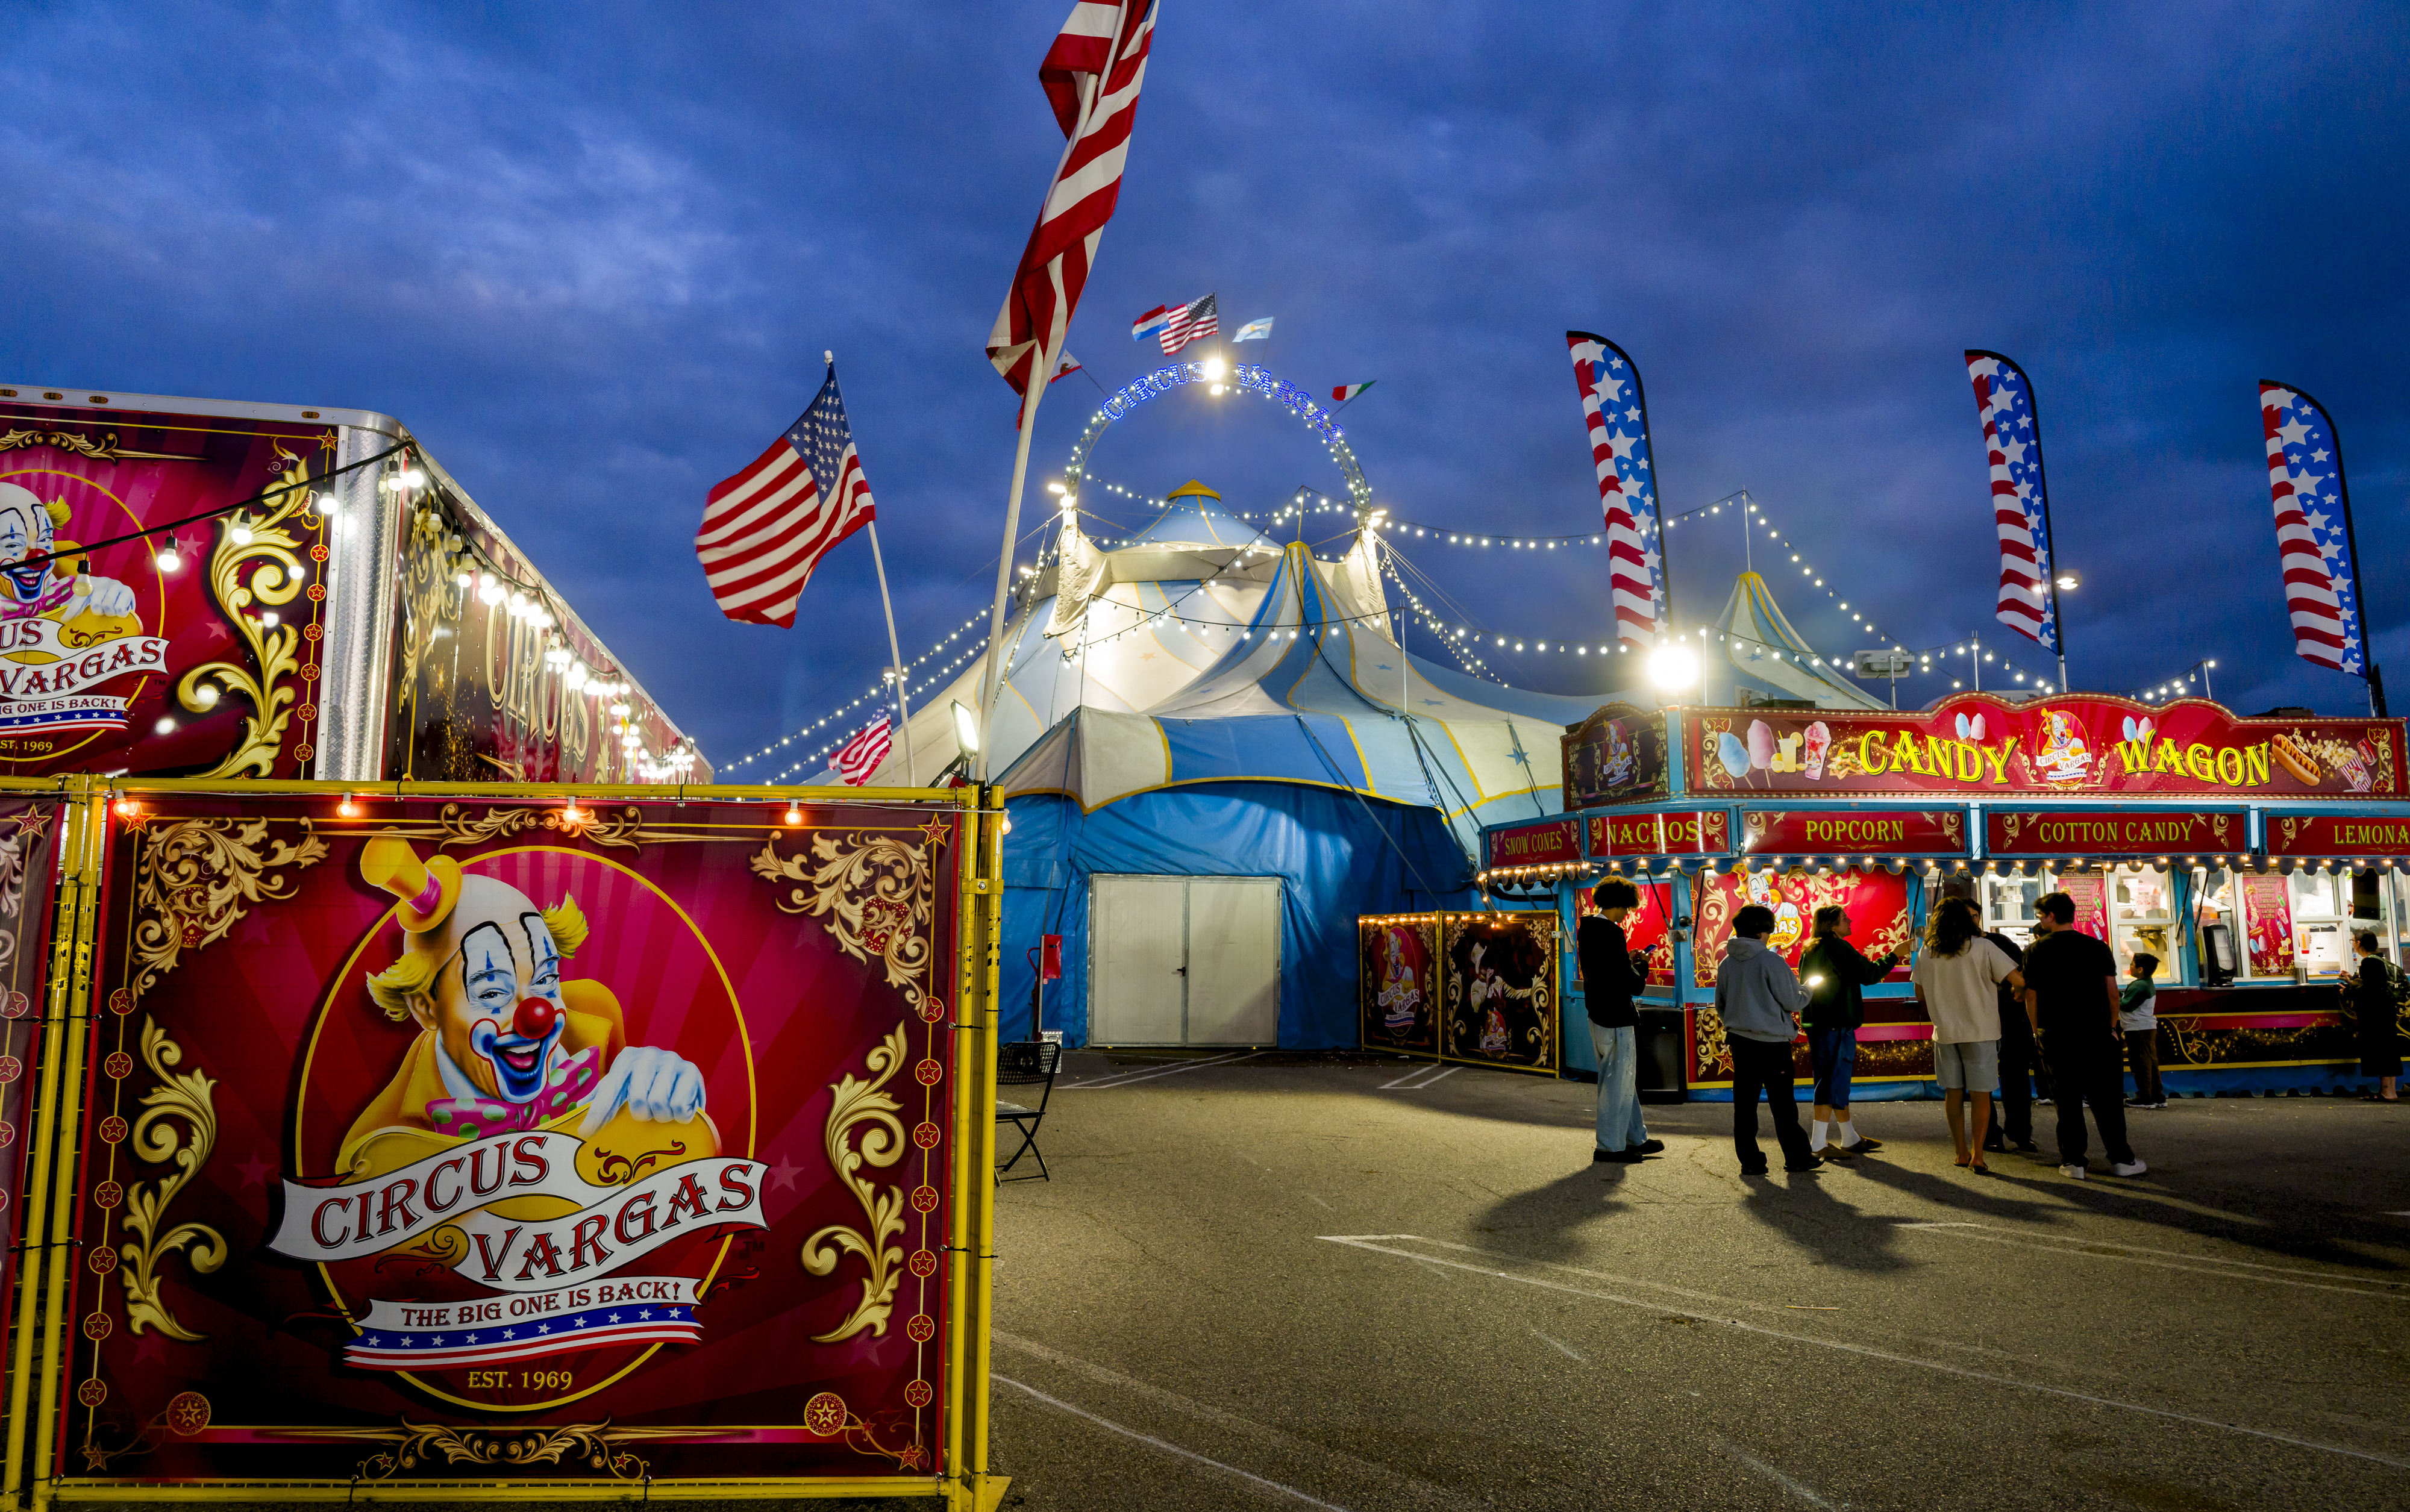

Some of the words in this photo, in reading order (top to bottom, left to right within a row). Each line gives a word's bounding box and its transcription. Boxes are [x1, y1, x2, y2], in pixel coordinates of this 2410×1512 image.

[1103, 361, 1207, 420] CIRCUS
[1238, 364, 1346, 443] VARGAS
[0, 640, 161, 695] VARGAS
[17, 702, 47, 713] ONE
[51, 700, 64, 710] IS
[69, 698, 117, 710] BACK!
[23, 741, 53, 752] 1969
[1860, 729, 2018, 784] CANDY
[2115, 728, 2270, 787] WAGON
[2040, 749, 2067, 765] CIRCUS
[1605, 755, 1620, 773] CIRCUS
[1615, 756, 1632, 775] VARGAS
[2059, 754, 2091, 769] VARGAS
[1606, 820, 1700, 845] NACHOS
[1805, 820, 1904, 842] POPCORN
[2039, 822, 2118, 843] COTTON
[2126, 818, 2196, 843] CANDY
[1505, 832, 1529, 856] SNOW
[1532, 830, 1563, 852] CONES
[1380, 983, 1400, 1004] CIRCUS
[1394, 990, 1418, 1012] VARGAS
[310, 1136, 550, 1248] CIRCUS
[471, 1163, 754, 1282] VARGAS
[743, 1241, 765, 1252] TM
[401, 1307, 451, 1327] THE
[458, 1302, 502, 1324] BIG
[510, 1293, 560, 1317] ONE
[568, 1288, 592, 1309] IS
[598, 1280, 681, 1304] BACK!
[468, 1371, 512, 1389] EST.
[521, 1371, 574, 1391] 1969
